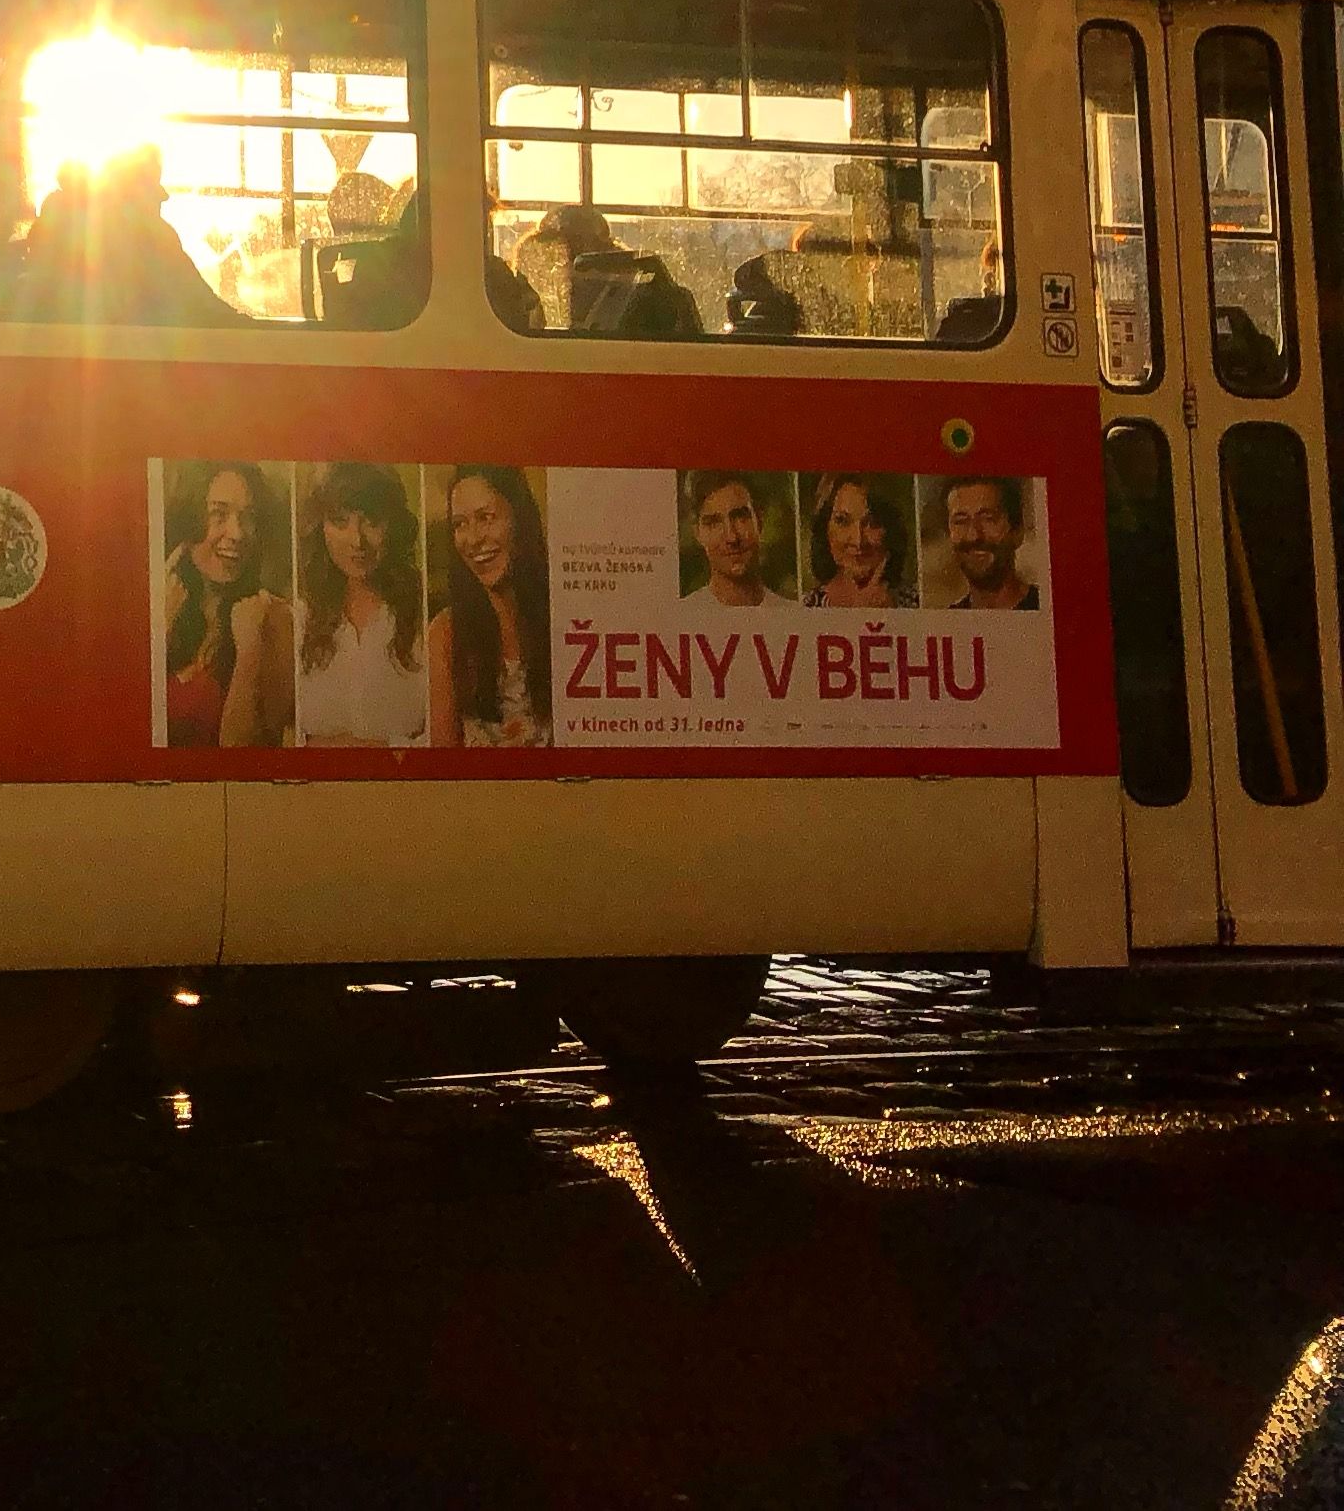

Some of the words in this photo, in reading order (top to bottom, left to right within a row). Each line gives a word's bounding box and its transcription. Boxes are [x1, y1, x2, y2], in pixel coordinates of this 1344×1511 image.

[563, 618, 741, 700] ŽENY
[752, 633, 800, 700] V
[815, 621, 988, 702] BĚHU
[566, 719, 578, 732] v
[581, 716, 640, 733] kinech
[643, 716, 663, 733] od
[669, 716, 694, 733] 31.
[698, 716, 746, 733] ledna
